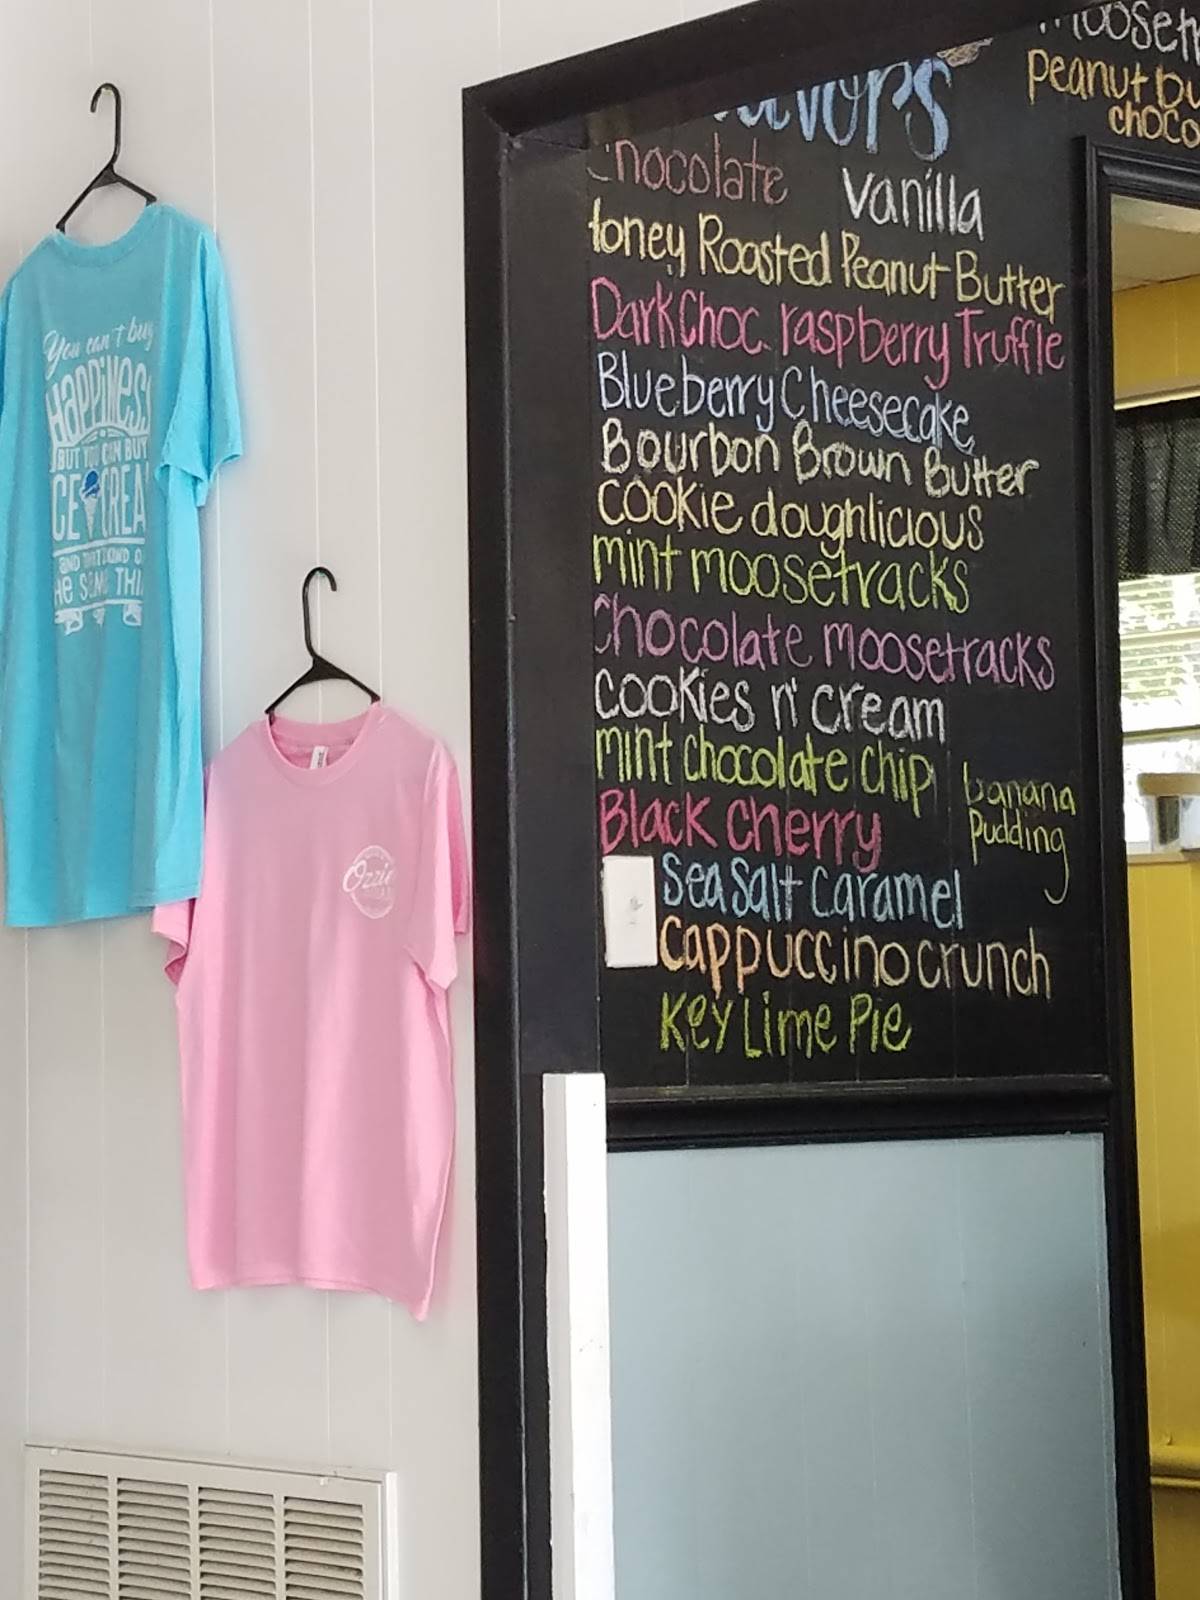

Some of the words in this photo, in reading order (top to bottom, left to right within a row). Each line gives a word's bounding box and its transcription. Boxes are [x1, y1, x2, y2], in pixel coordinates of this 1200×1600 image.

[699, 213, 831, 287] Roasted
[841, 231, 951, 300] Peanut
[955, 250, 1066, 324] Butter
[591, 277, 675, 348] Dark
[780, 303, 950, 390] raspberry
[955, 308, 1066, 375] Truffle
[599, 351, 774, 432] Blueberry
[780, 365, 975, 454] Cheesecake
[601, 418, 780, 477] Bourbon
[792, 419, 913, 486] Brown
[924, 446, 1039, 499] Butter
[691, 546, 971, 614] moosetracks
[601, 788, 719, 854] Black
[662, 852, 728, 915] Sea
[730, 857, 804, 922] Salt
[743, 990, 837, 1059] Lime
[849, 992, 913, 1052] Pie
